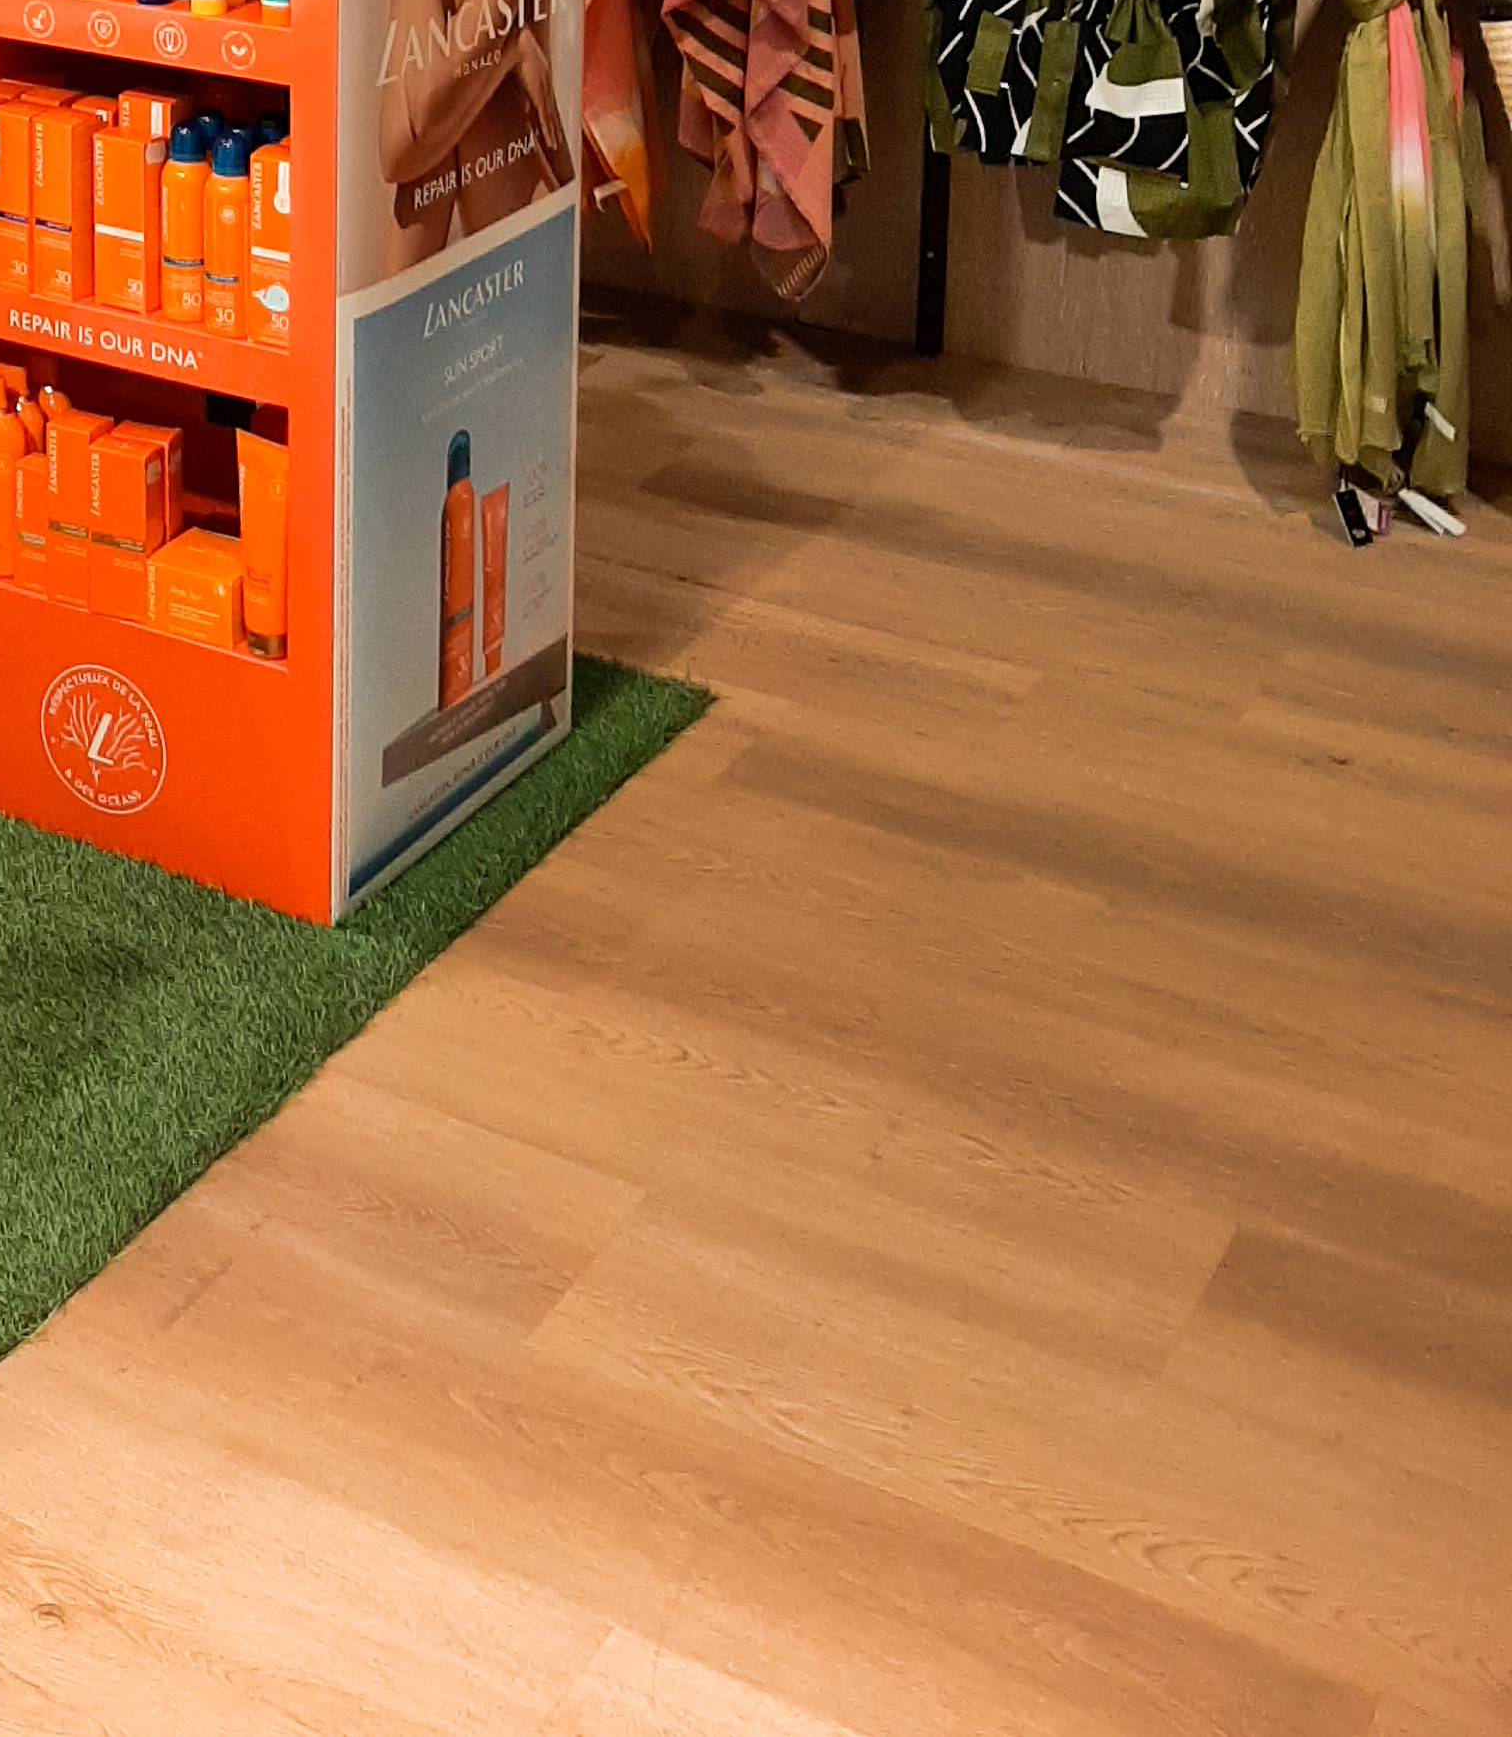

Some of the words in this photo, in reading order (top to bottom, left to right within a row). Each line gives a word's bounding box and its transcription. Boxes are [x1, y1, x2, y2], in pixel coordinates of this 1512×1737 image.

[414, 170, 457, 210] REPAIR
[461, 162, 472, 187] IS
[475, 148, 504, 179] OUR
[271, 313, 289, 330] 50
[423, 260, 524, 339] LANCASTER
[9, 309, 71, 340] REPAIR
[78, 325, 94, 346] IS
[99, 331, 144, 358] OUR
